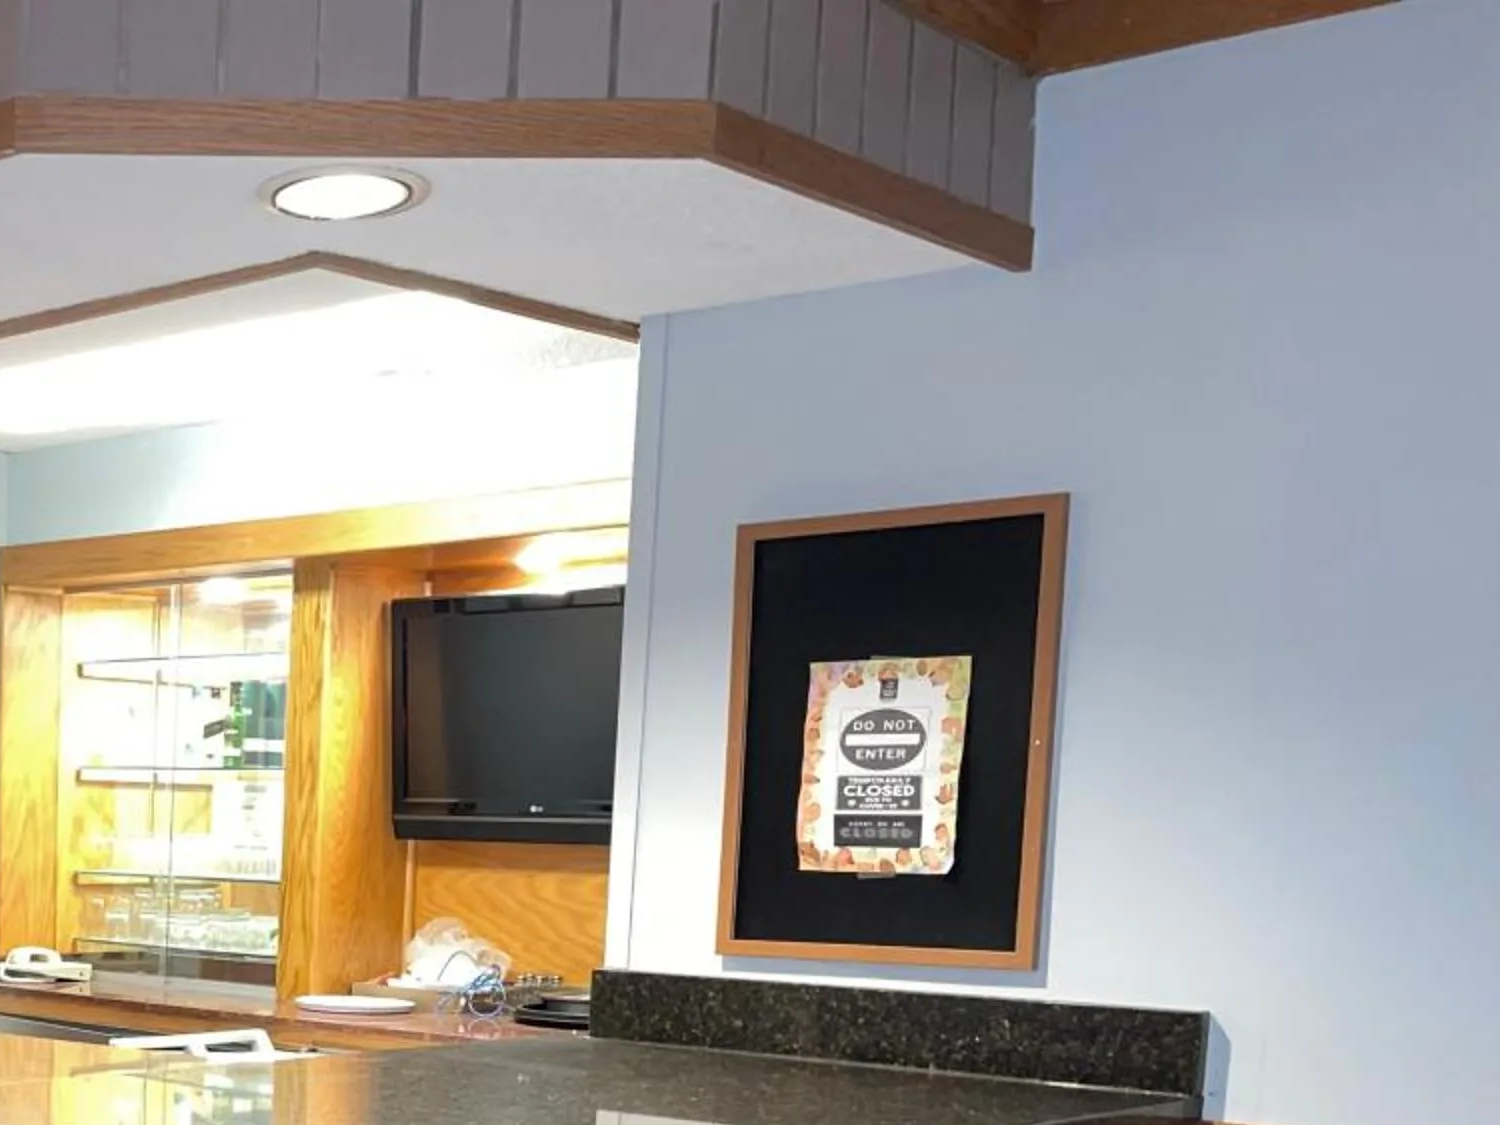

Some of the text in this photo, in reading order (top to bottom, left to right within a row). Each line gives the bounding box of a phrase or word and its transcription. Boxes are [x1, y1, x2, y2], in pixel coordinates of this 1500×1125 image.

[853, 719, 917, 732] DO NOT
[855, 747, 907, 760] ENTER
[843, 785, 915, 797] CLOSED
